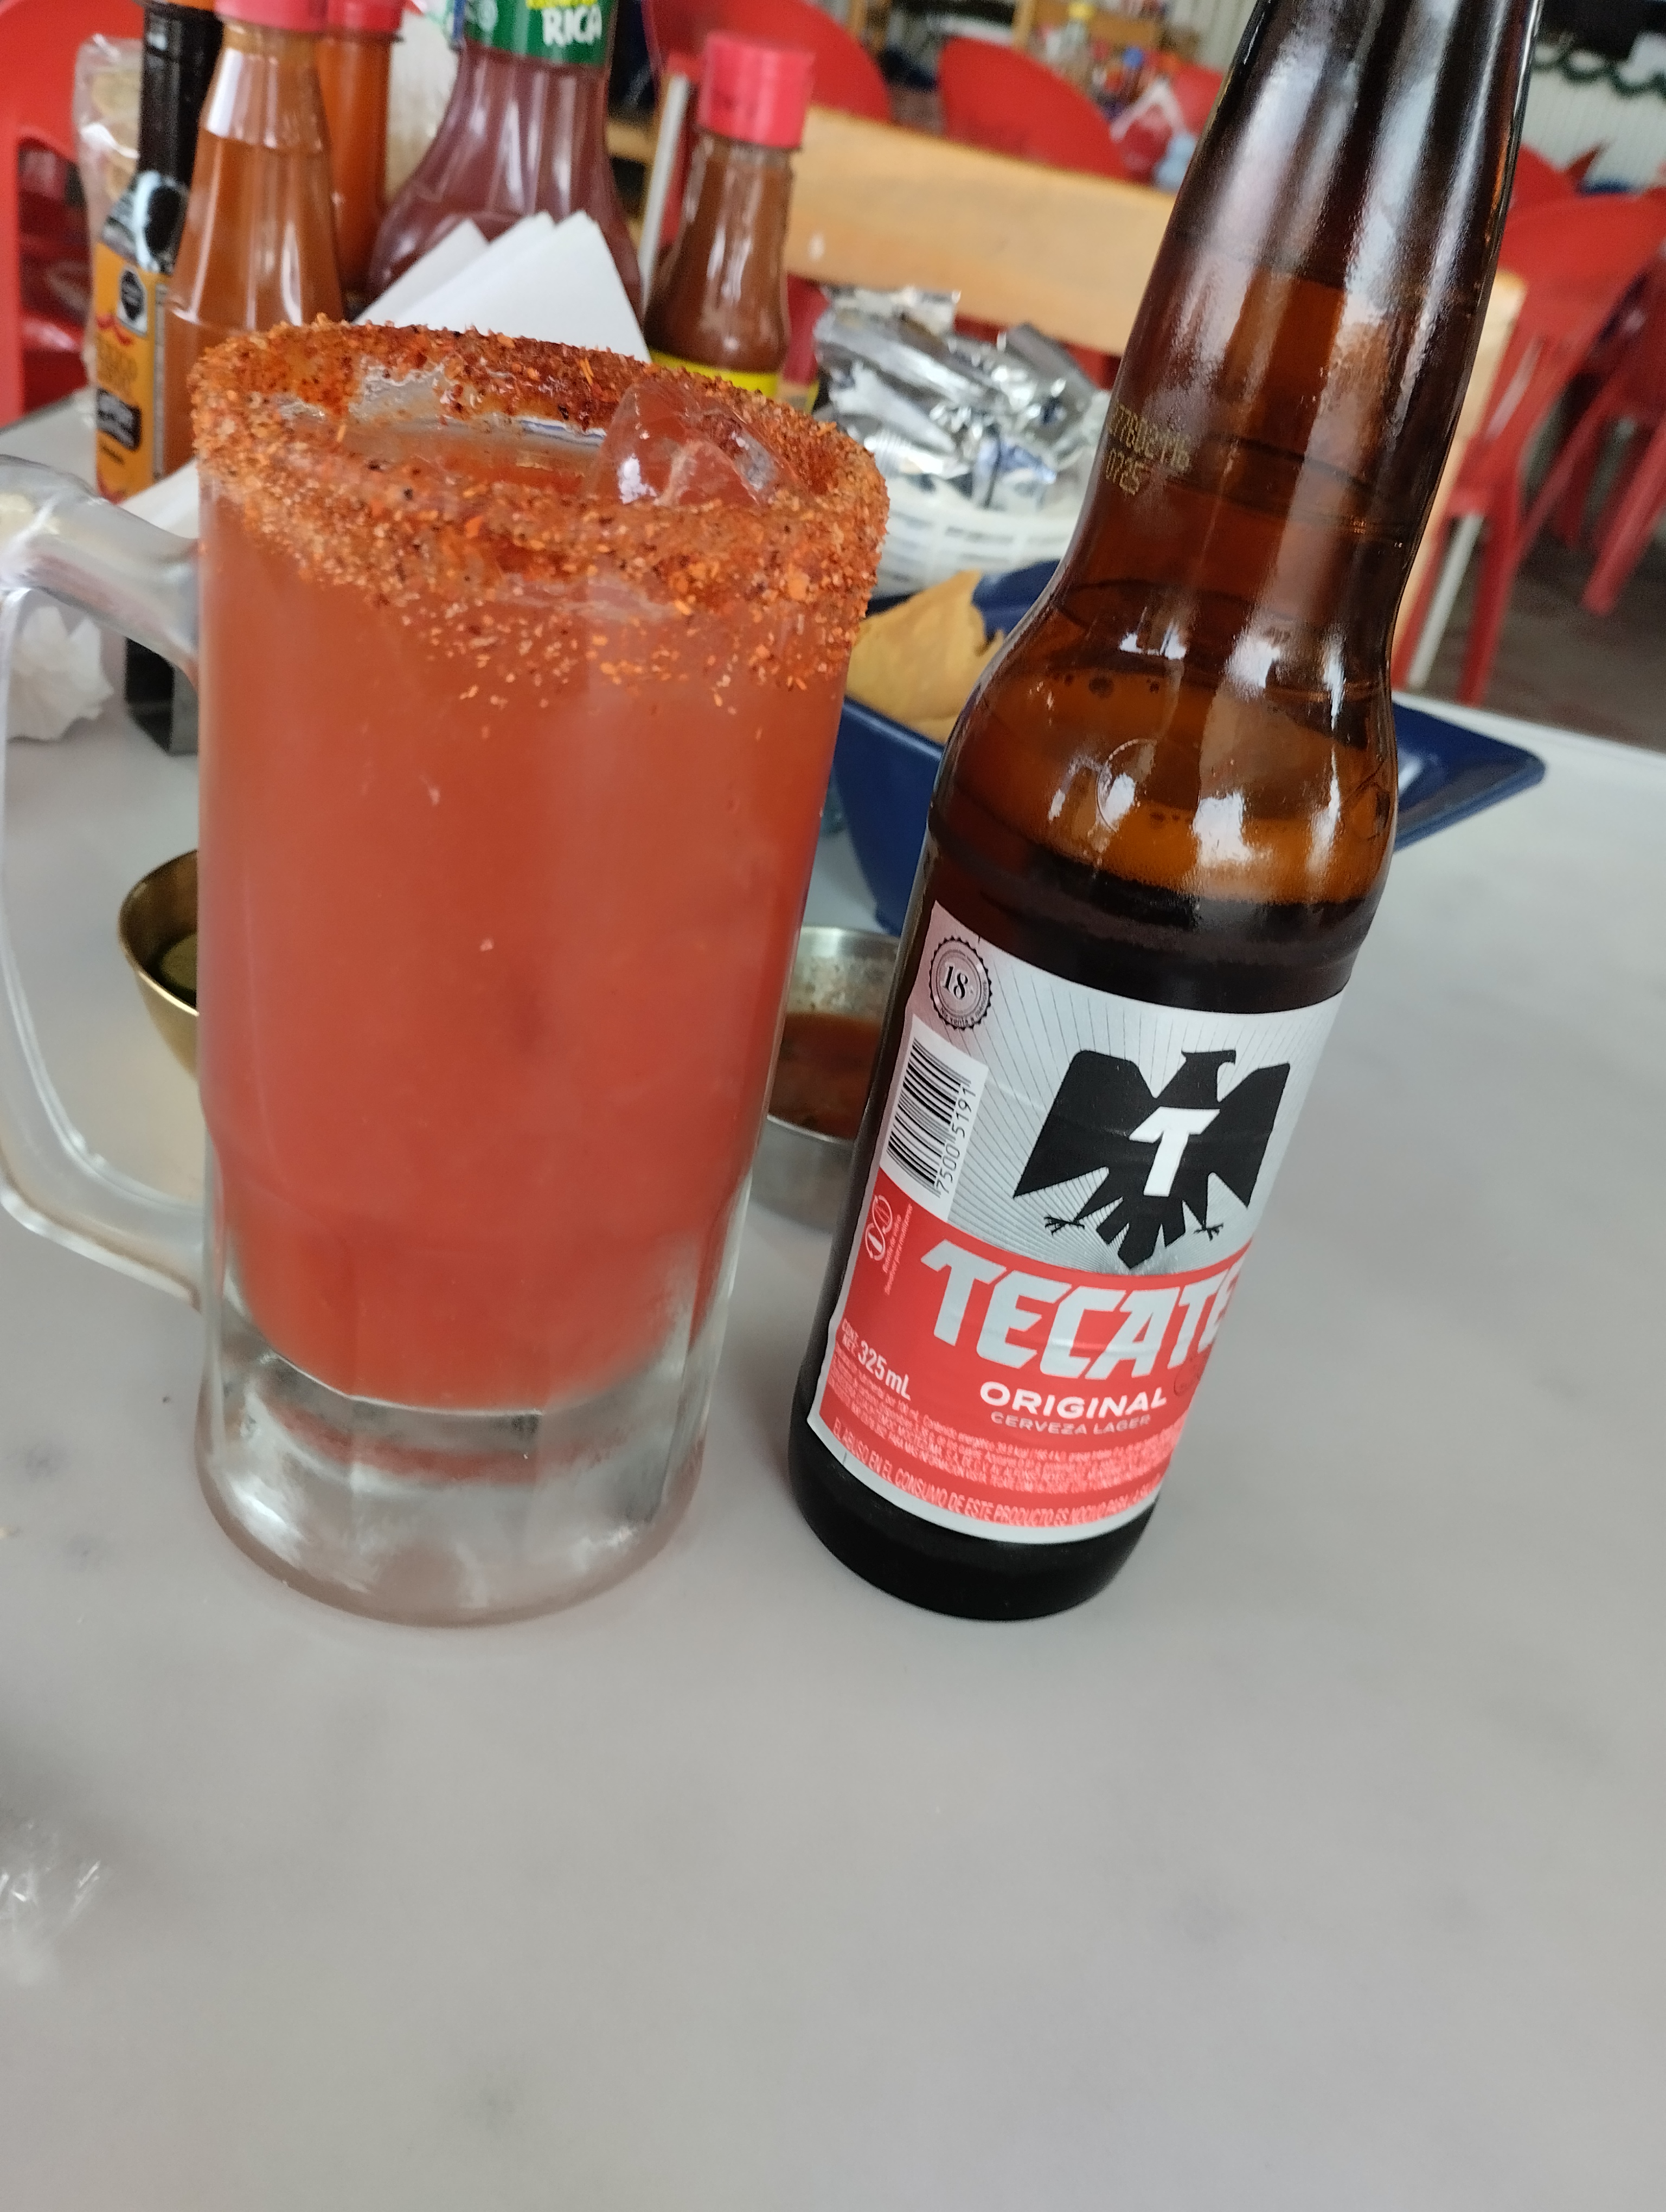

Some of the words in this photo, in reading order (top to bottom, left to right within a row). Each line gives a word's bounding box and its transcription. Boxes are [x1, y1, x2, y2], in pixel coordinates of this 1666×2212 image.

[543, 4, 602, 47] RICA
[936, 1143, 960, 1194] 7500
[951, 1087, 976, 1139] 5191
[1129, 1108, 1220, 1197] T
[920, 1238, 1246, 1380] TECATE
[858, 1340, 887, 1381] 325
[885, 1369, 911, 1401] mL
[980, 1381, 1167, 1419] ORIGINAL
[990, 1411, 1087, 1435] CERVEZA
[1093, 1413, 1151, 1435] LAGER
[832, 1416, 845, 1442] EL
[868, 1449, 883, 1473] EN
[881, 1458, 896, 1482] EL
[894, 1465, 948, 1507] CONSUMO
[948, 1490, 964, 1514] DE
